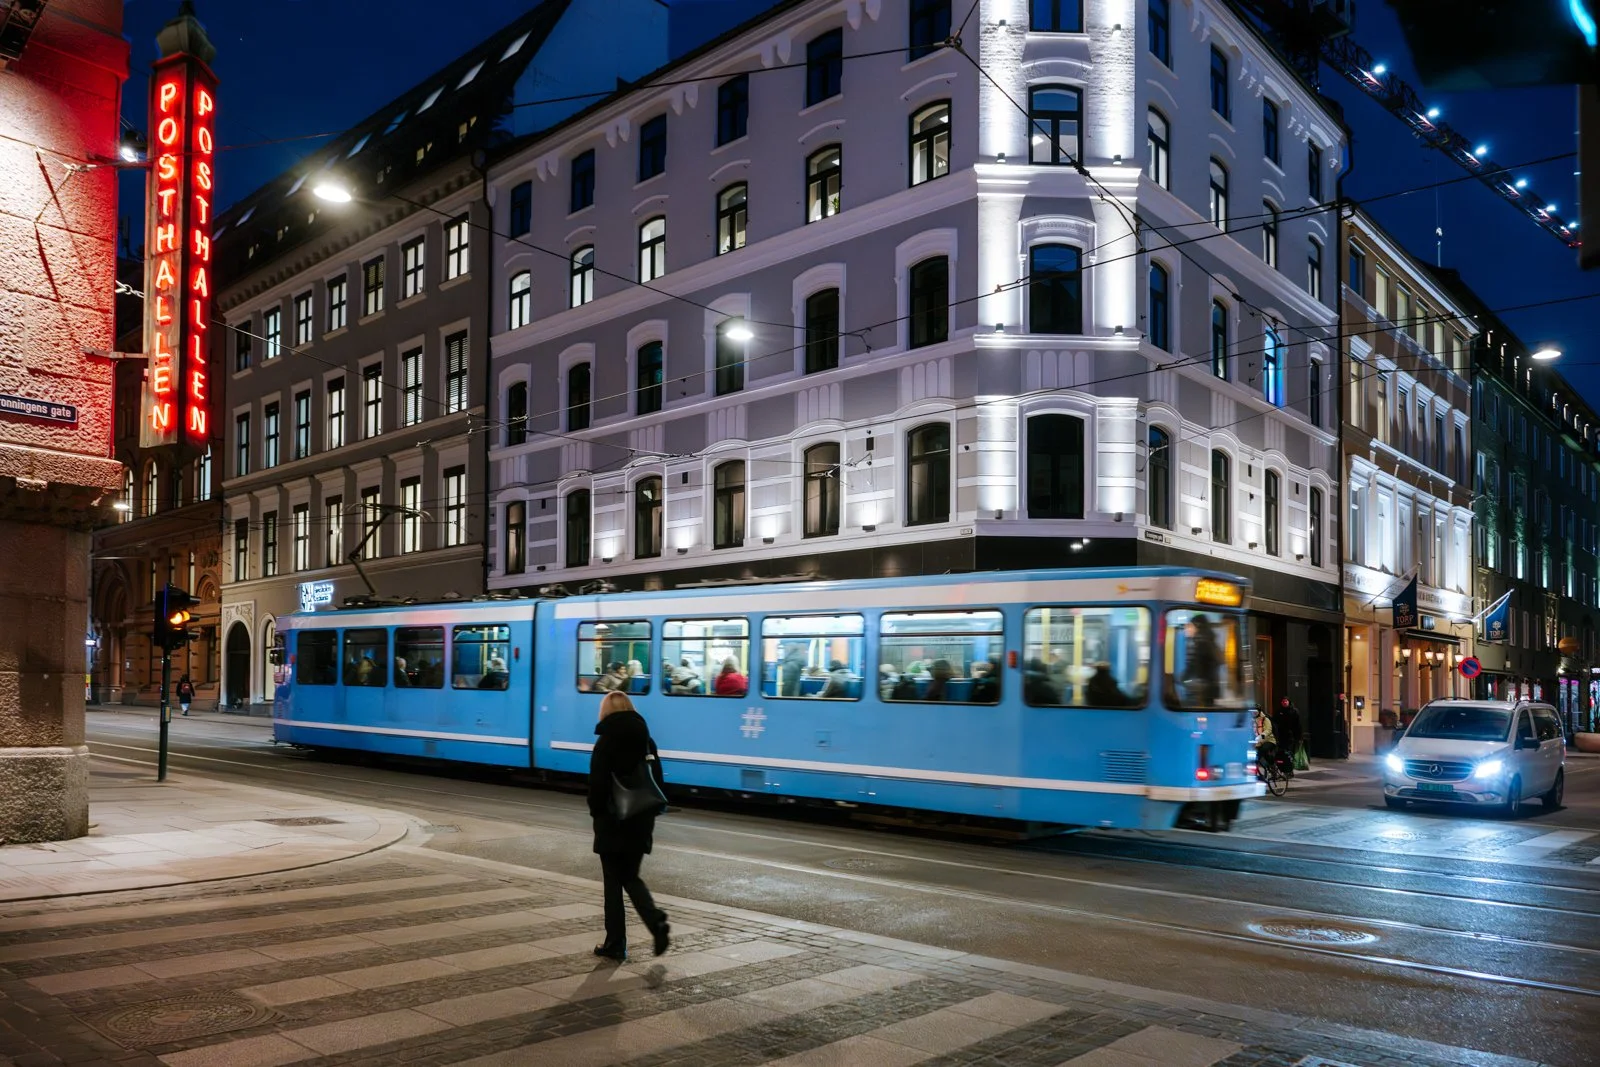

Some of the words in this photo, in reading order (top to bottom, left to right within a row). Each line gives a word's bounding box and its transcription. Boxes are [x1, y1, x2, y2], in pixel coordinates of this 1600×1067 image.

[0, 398, 48, 414] onningens
[51, 407, 72, 418] gate
[152, 82, 177, 430] POSTHALLEN
[190, 89, 214, 435] POSTHALLEN
